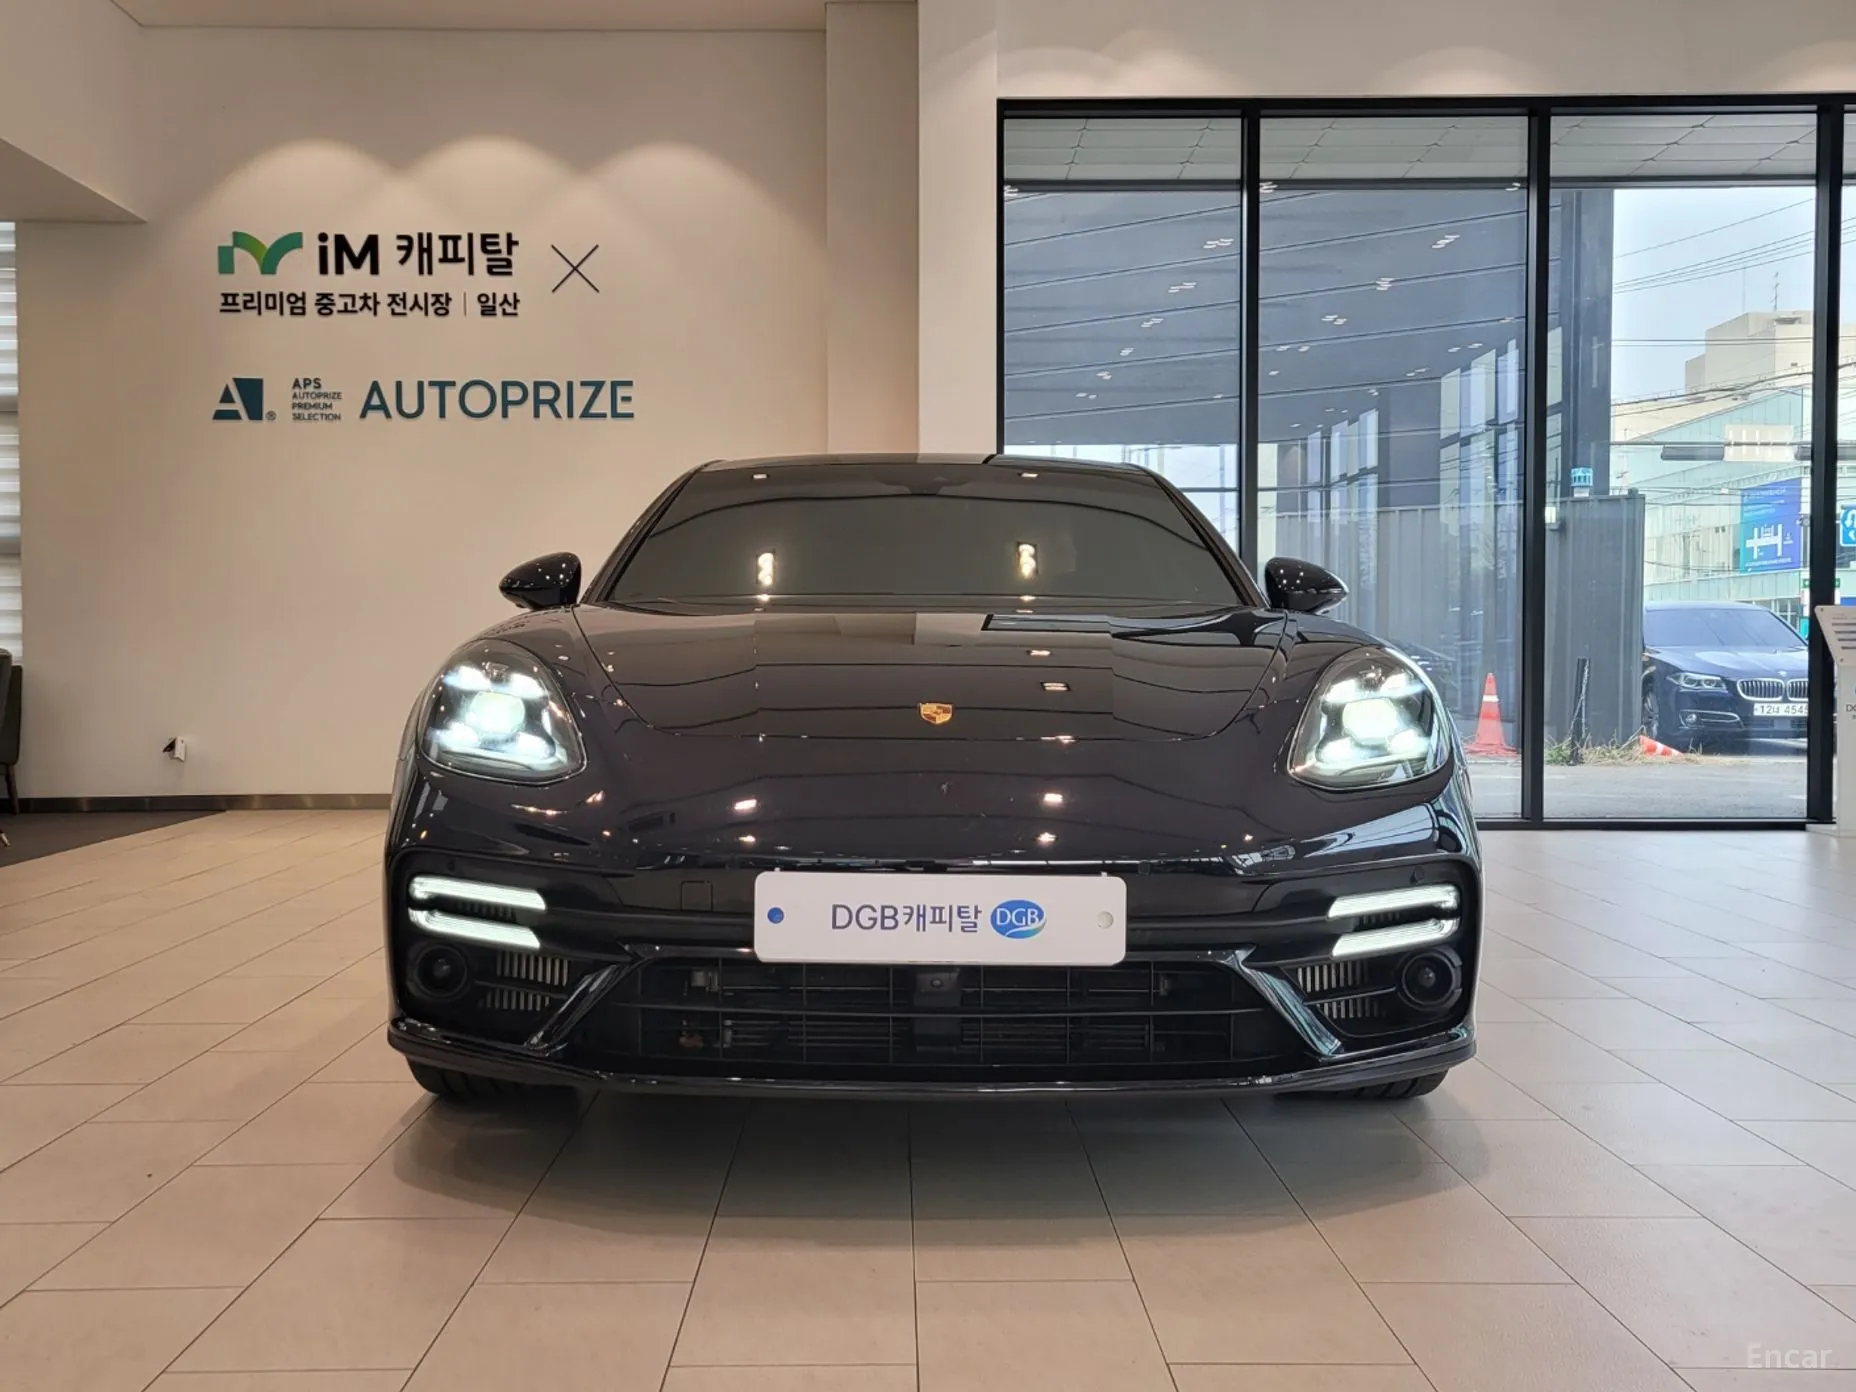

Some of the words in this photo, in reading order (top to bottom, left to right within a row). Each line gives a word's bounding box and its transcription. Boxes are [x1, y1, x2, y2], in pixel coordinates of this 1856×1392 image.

[318, 232, 379, 276] iM
[396, 231, 519, 276] 캐피탈
[219, 291, 307, 317] 프리미엄
[314, 291, 380, 317] 중고차
[387, 291, 452, 317] 전시장
[477, 291, 520, 317] 일산
[292, 377, 322, 390] APS
[292, 391, 342, 400] AUTOPRIZE
[359, 379, 635, 420] AUTOPRIZE
[292, 402, 332, 410] PREMIUM
[292, 412, 342, 421] SELECTION
[831, 903, 983, 934] DGB캐피탈
[996, 907, 1040, 927] DGB
